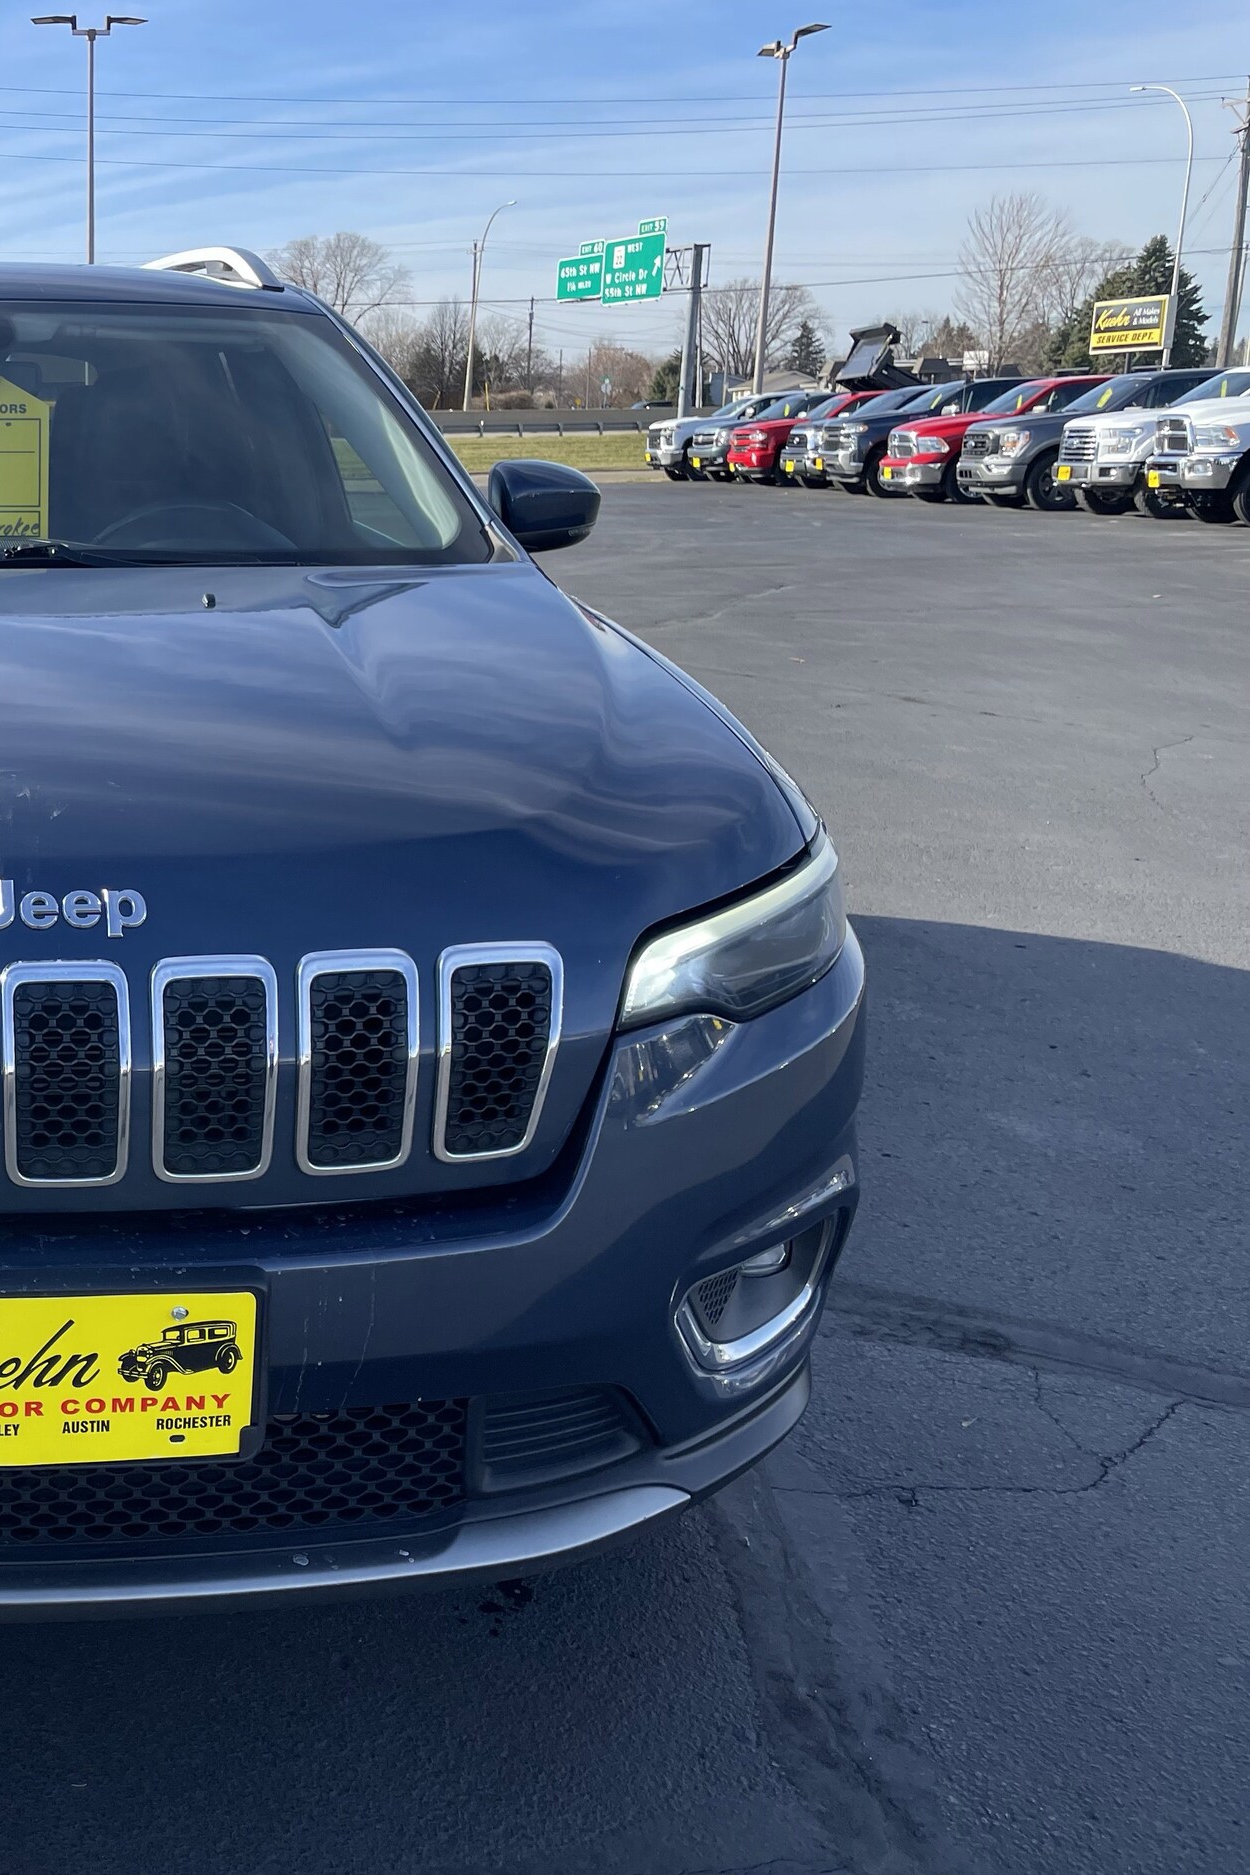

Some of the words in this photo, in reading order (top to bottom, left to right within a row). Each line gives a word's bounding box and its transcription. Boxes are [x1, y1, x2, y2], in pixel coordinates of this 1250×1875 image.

[654, 220, 665, 232] 59
[593, 241, 603, 253] 60
[627, 242, 643, 253] WEST
[560, 267, 577, 278] 65th
[579, 265, 587, 276] St
[589, 262, 601, 274] NW
[615, 270, 636, 284] Circle
[638, 268, 648, 280] Dr
[604, 287, 622, 298] 55th
[625, 286, 633, 297] St
[635, 284, 647, 295] NW
[1133, 307, 1142, 316] All
[1143, 306, 1160, 315] Makes
[1095, 307, 1130, 330] Kuehn
[1132, 318, 1138, 326] &
[1139, 316, 1159, 324] Models
[1096, 333, 1130, 344] SERVICE
[1131, 331, 1154, 341] DEPT.
[60, 1393, 232, 1416] COMPANY
[62, 1420, 110, 1434] AUSTIN
[155, 1414, 232, 1430] ROCHESTER
